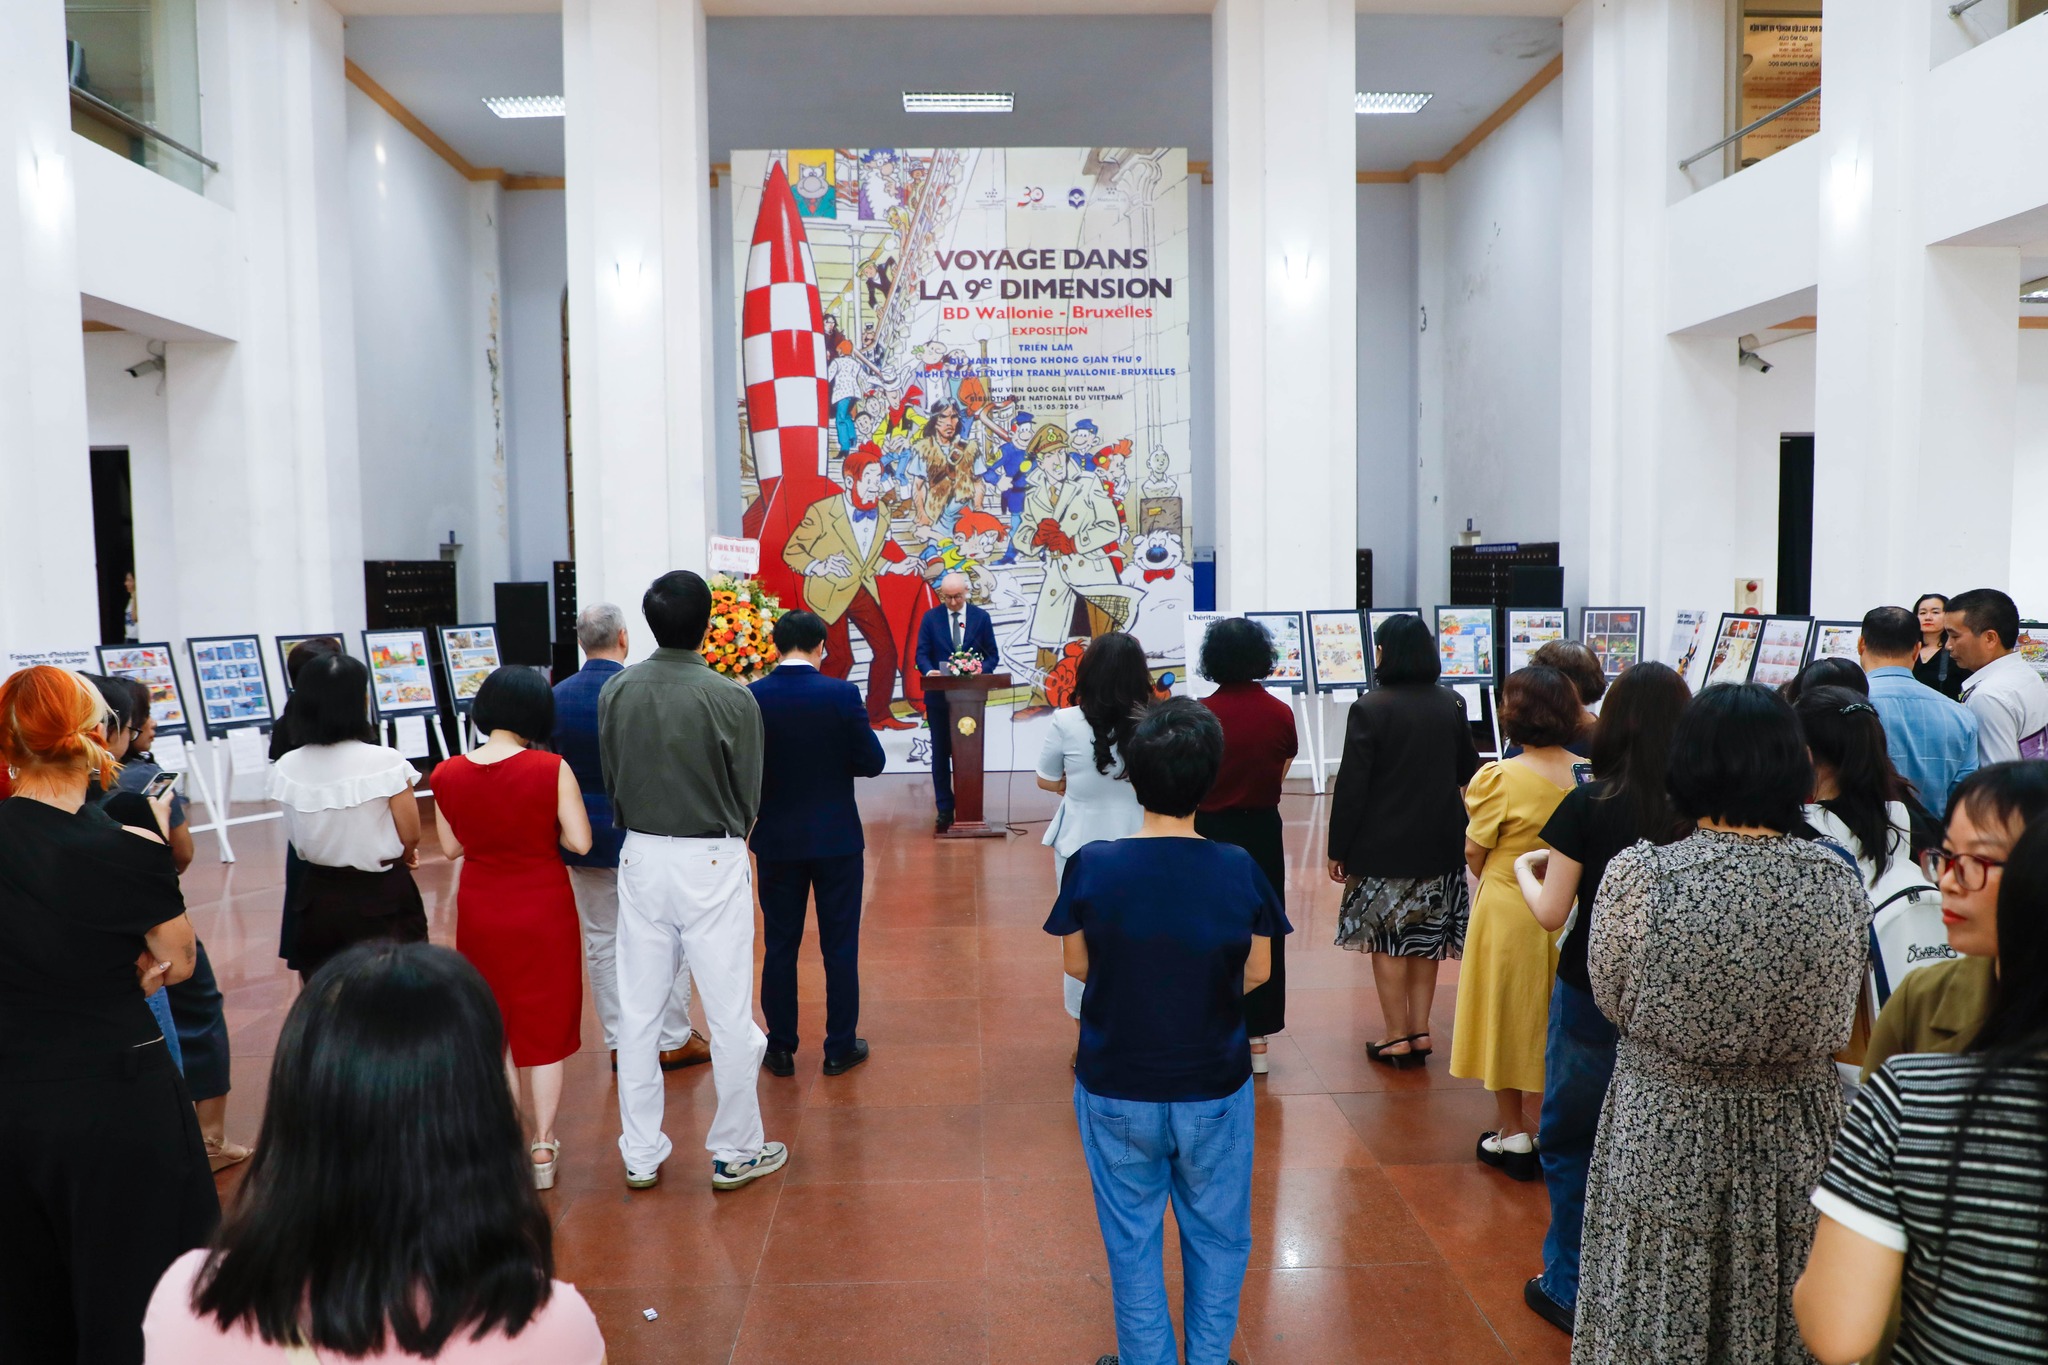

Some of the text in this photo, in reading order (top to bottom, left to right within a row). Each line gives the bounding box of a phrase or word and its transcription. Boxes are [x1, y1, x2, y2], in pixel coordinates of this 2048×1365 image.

[934, 248, 1148, 271] VOYAGE DANS
[920, 279, 958, 300] LA
[1001, 278, 1172, 299] DIMENSION
[943, 307, 970, 320] BD
[976, 306, 1053, 320] Wallonie
[1073, 305, 1153, 319] Bruxelles
[1012, 326, 1088, 336] EXPOSITION
[1001, 356, 1037, 365] TRONG
[1083, 355, 1108, 364] GIAN
[1136, 355, 1142, 363] 9
[1027, 368, 1061, 377] TRANH
[1064, 367, 1176, 376] WALLONIE-BRUXELLES
[1029, 394, 1072, 402] NATIONALE
